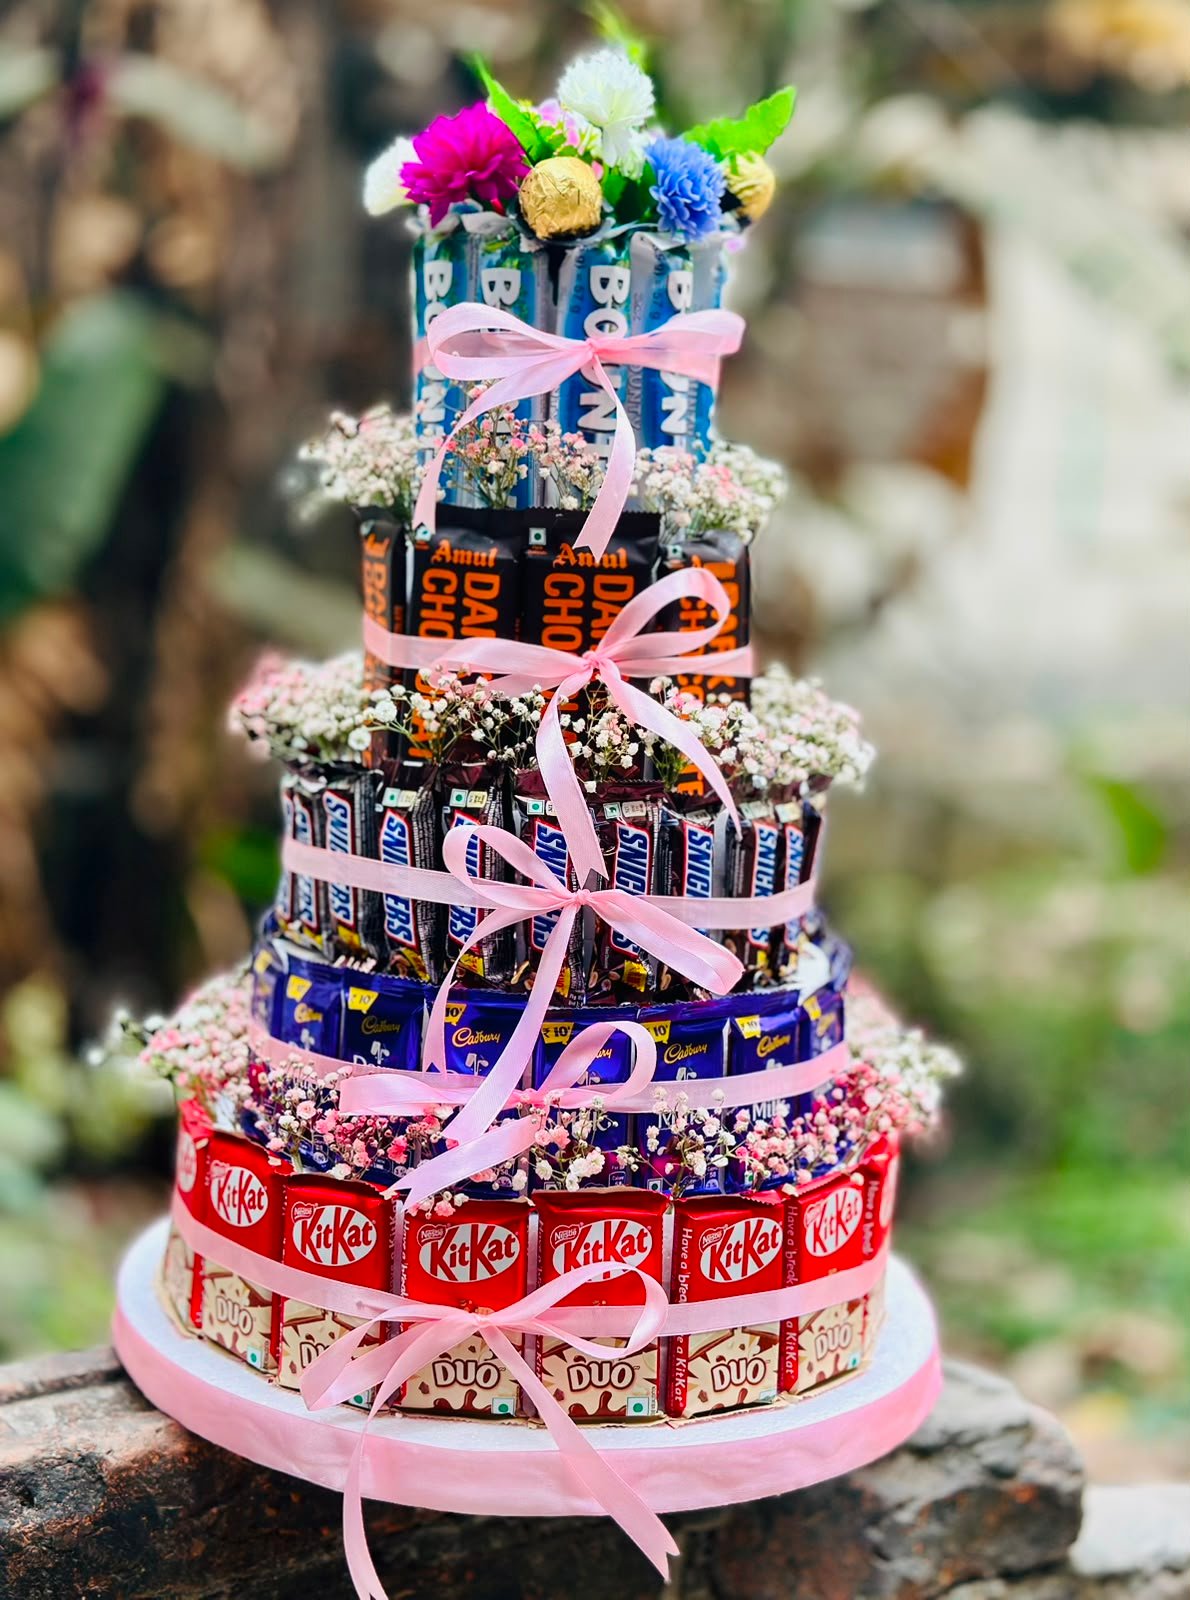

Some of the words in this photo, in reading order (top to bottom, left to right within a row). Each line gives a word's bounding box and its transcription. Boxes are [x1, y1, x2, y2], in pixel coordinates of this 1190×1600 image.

[431, 539, 498, 567] Amul
[452, 1027, 501, 1048] Cadbury
[664, 1043, 708, 1064] Cadbury
[216, 1171, 265, 1224] KitKat
[300, 1207, 375, 1264] KitKat
[786, 1205, 798, 1236] Have
[812, 1191, 861, 1254] KitKat
[429, 1224, 516, 1281] KitKat
[562, 1221, 648, 1280] KitKat
[680, 1227, 693, 1258] Have
[708, 1220, 781, 1281] KitKat
[681, 1261, 689, 1269] a
[215, 1297, 254, 1335] DUO
[785, 1331, 797, 1375] KitKat
[814, 1325, 852, 1362] DUO
[432, 1359, 500, 1389] DUO
[567, 1361, 635, 1392] DUO
[673, 1357, 687, 1402] KitKat
[710, 1358, 767, 1393] DUO
